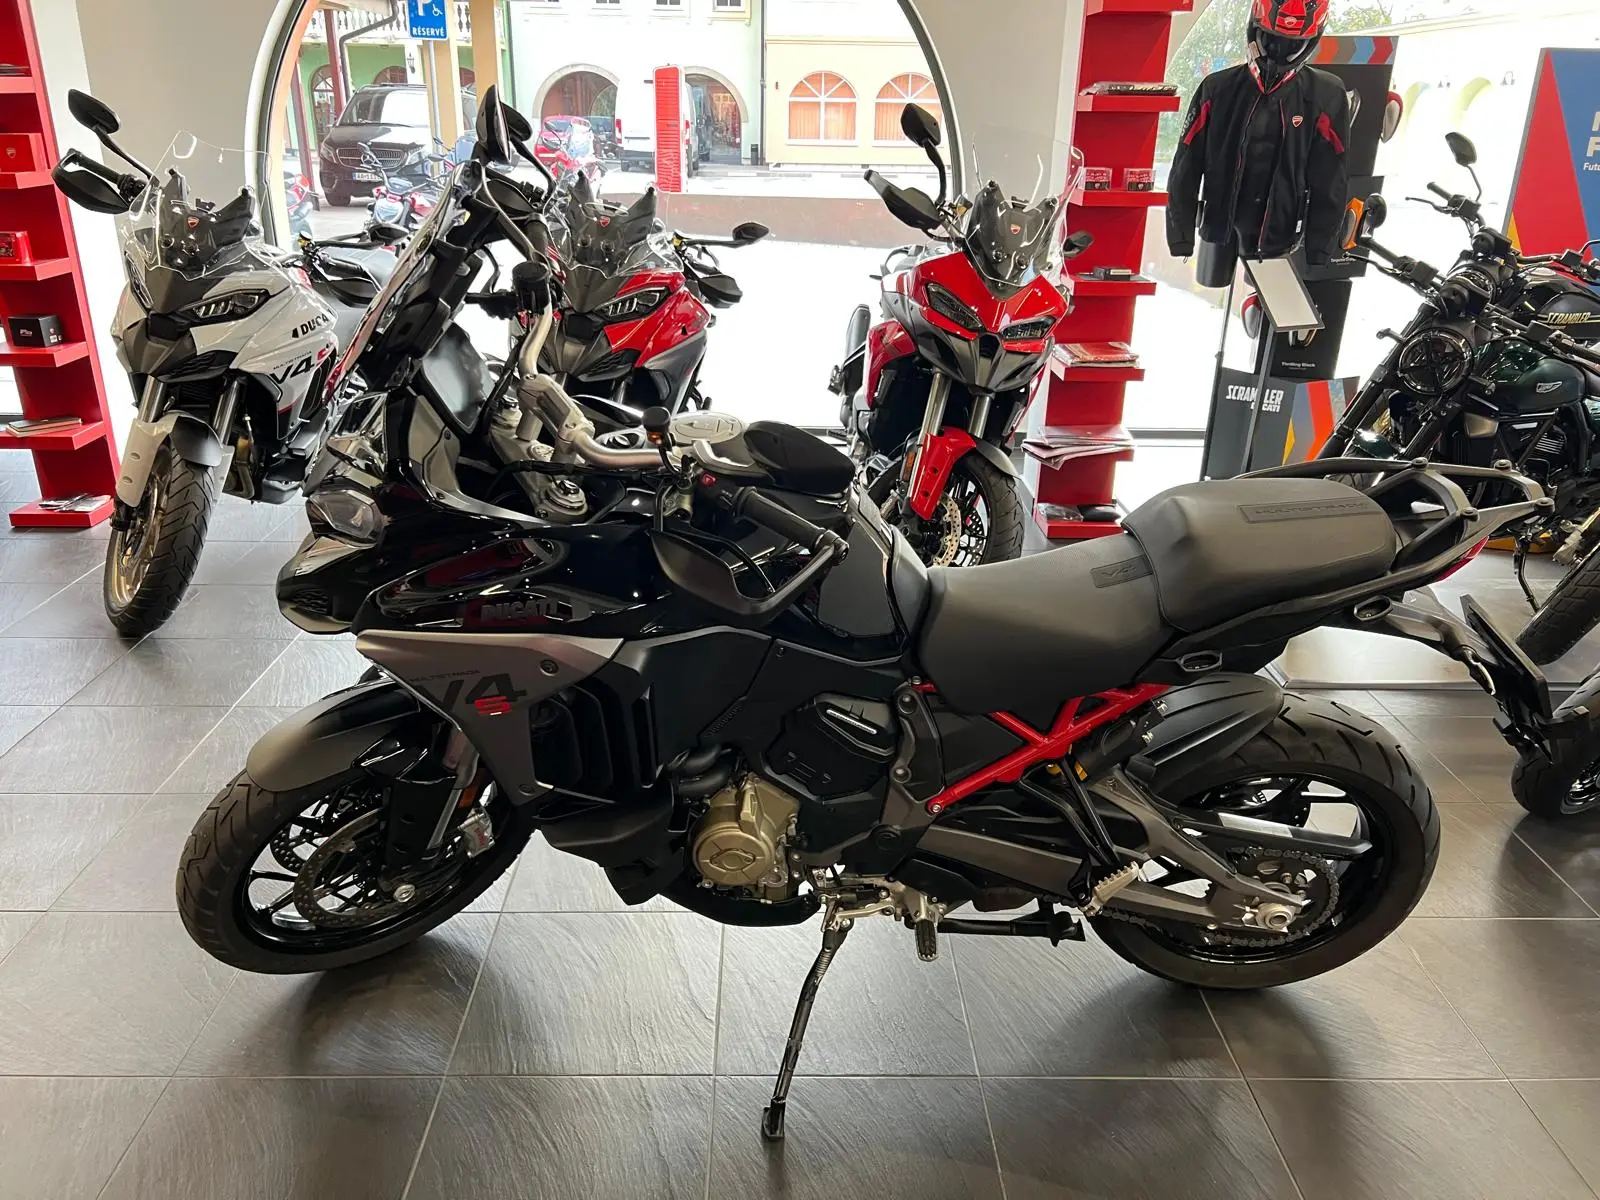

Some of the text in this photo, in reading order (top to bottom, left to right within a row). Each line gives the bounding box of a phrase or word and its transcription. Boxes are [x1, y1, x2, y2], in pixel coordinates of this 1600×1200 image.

[412, 25, 445, 37] RÉSERVÉ
[1547, 311, 1592, 325] SCRAMBLER
[1226, 385, 1284, 404] SCRAMLER
